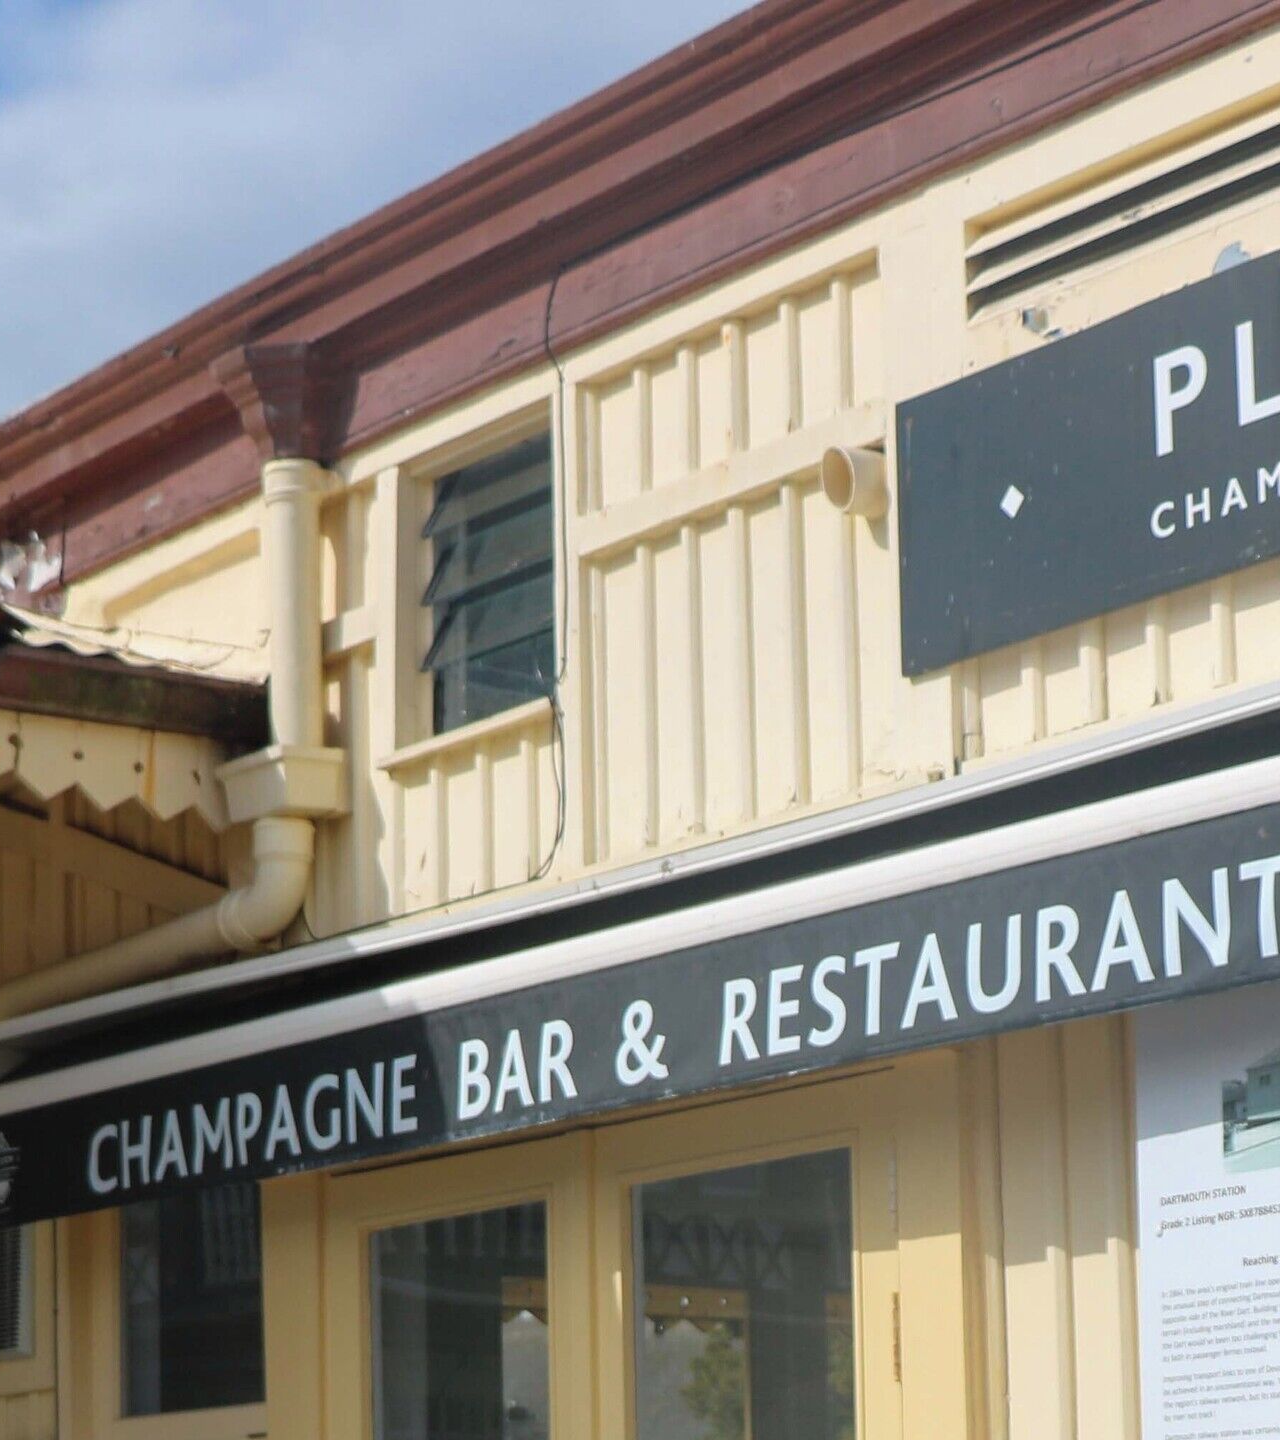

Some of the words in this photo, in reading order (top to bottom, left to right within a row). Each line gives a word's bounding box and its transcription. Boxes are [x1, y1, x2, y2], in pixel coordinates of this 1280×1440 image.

[87, 1054, 417, 1194] CHAMPAGNE
[457, 1018, 578, 1121] BAR
[616, 1000, 670, 1086] &
[1160, 1190, 1211, 1206] DARTMOUTH
[1212, 1185, 1247, 1199] STATION
[1160, 1218, 1183, 1230] Grade
[1184, 1217, 1190, 1226] 2
[1191, 1214, 1216, 1225] Listing
[1242, 1254, 1278, 1266] Reaching
